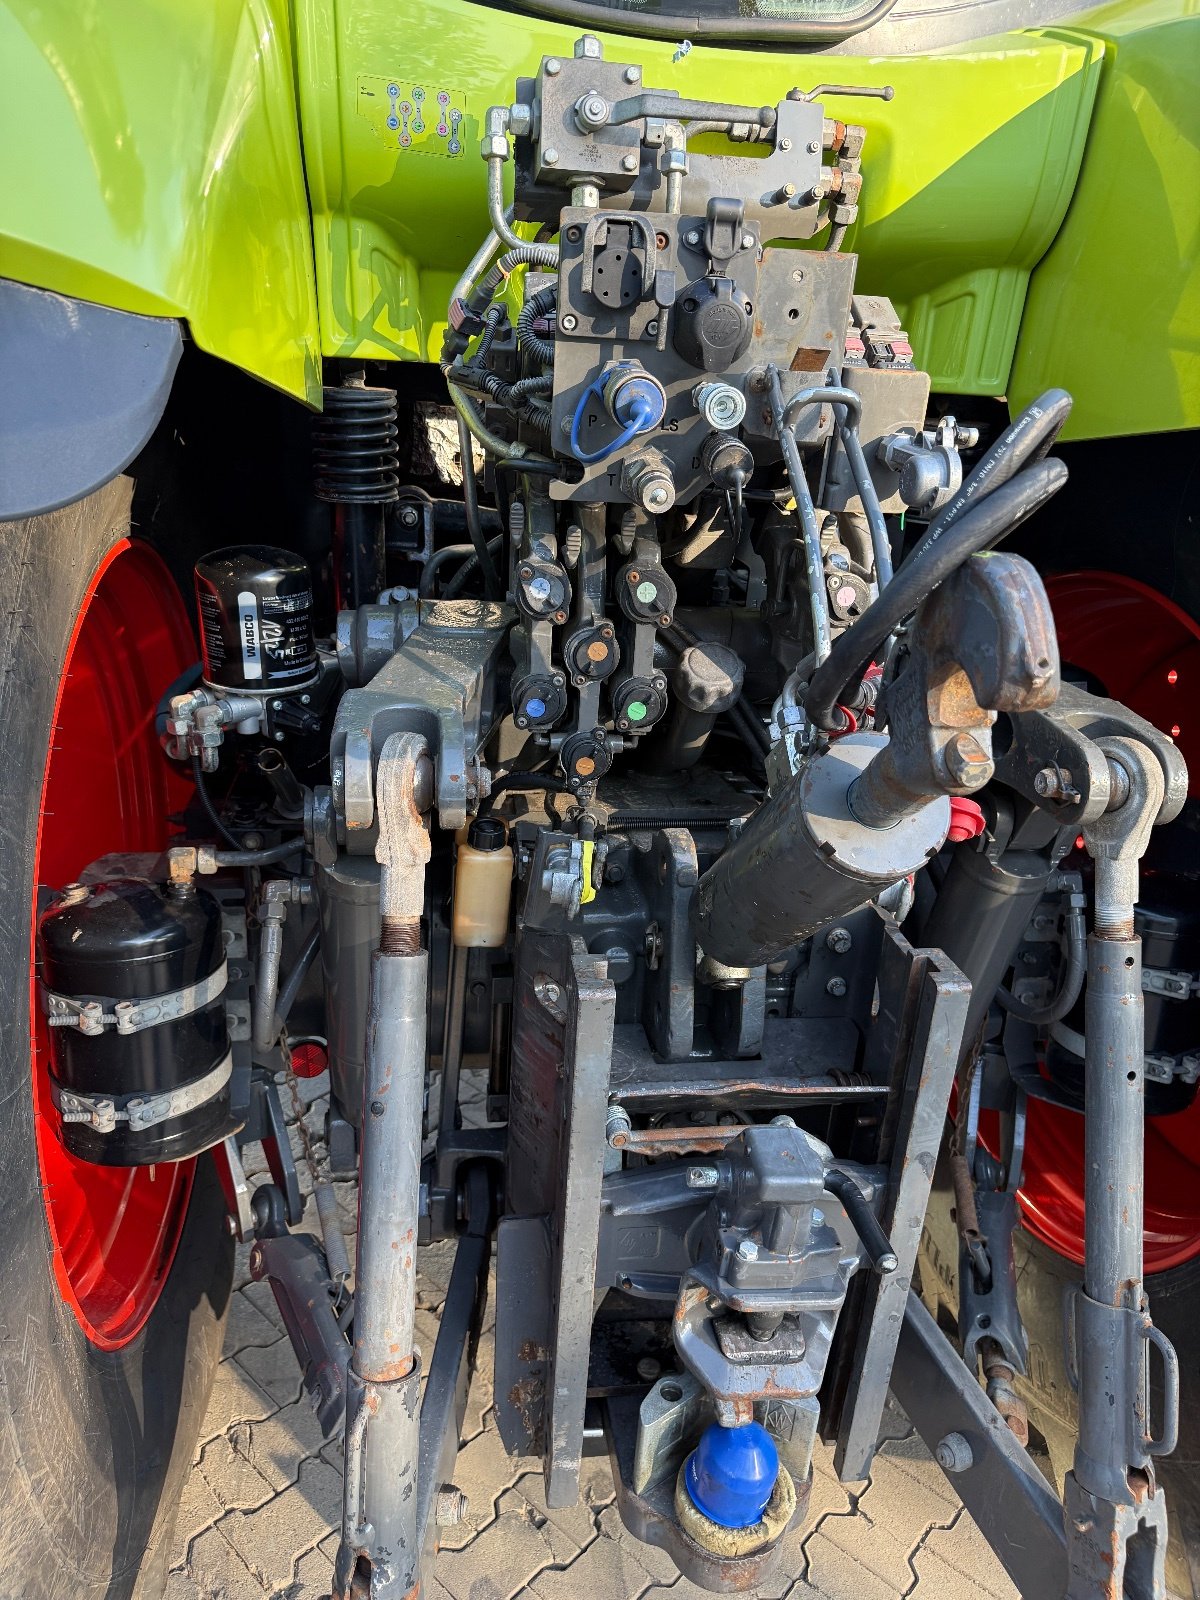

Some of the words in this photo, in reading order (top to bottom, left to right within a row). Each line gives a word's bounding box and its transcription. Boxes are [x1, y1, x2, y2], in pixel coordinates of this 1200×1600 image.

[588, 414, 598, 427] P
[660, 418, 679, 432] LS
[607, 473, 617, 487] T
[244, 614, 257, 658] WABCO
